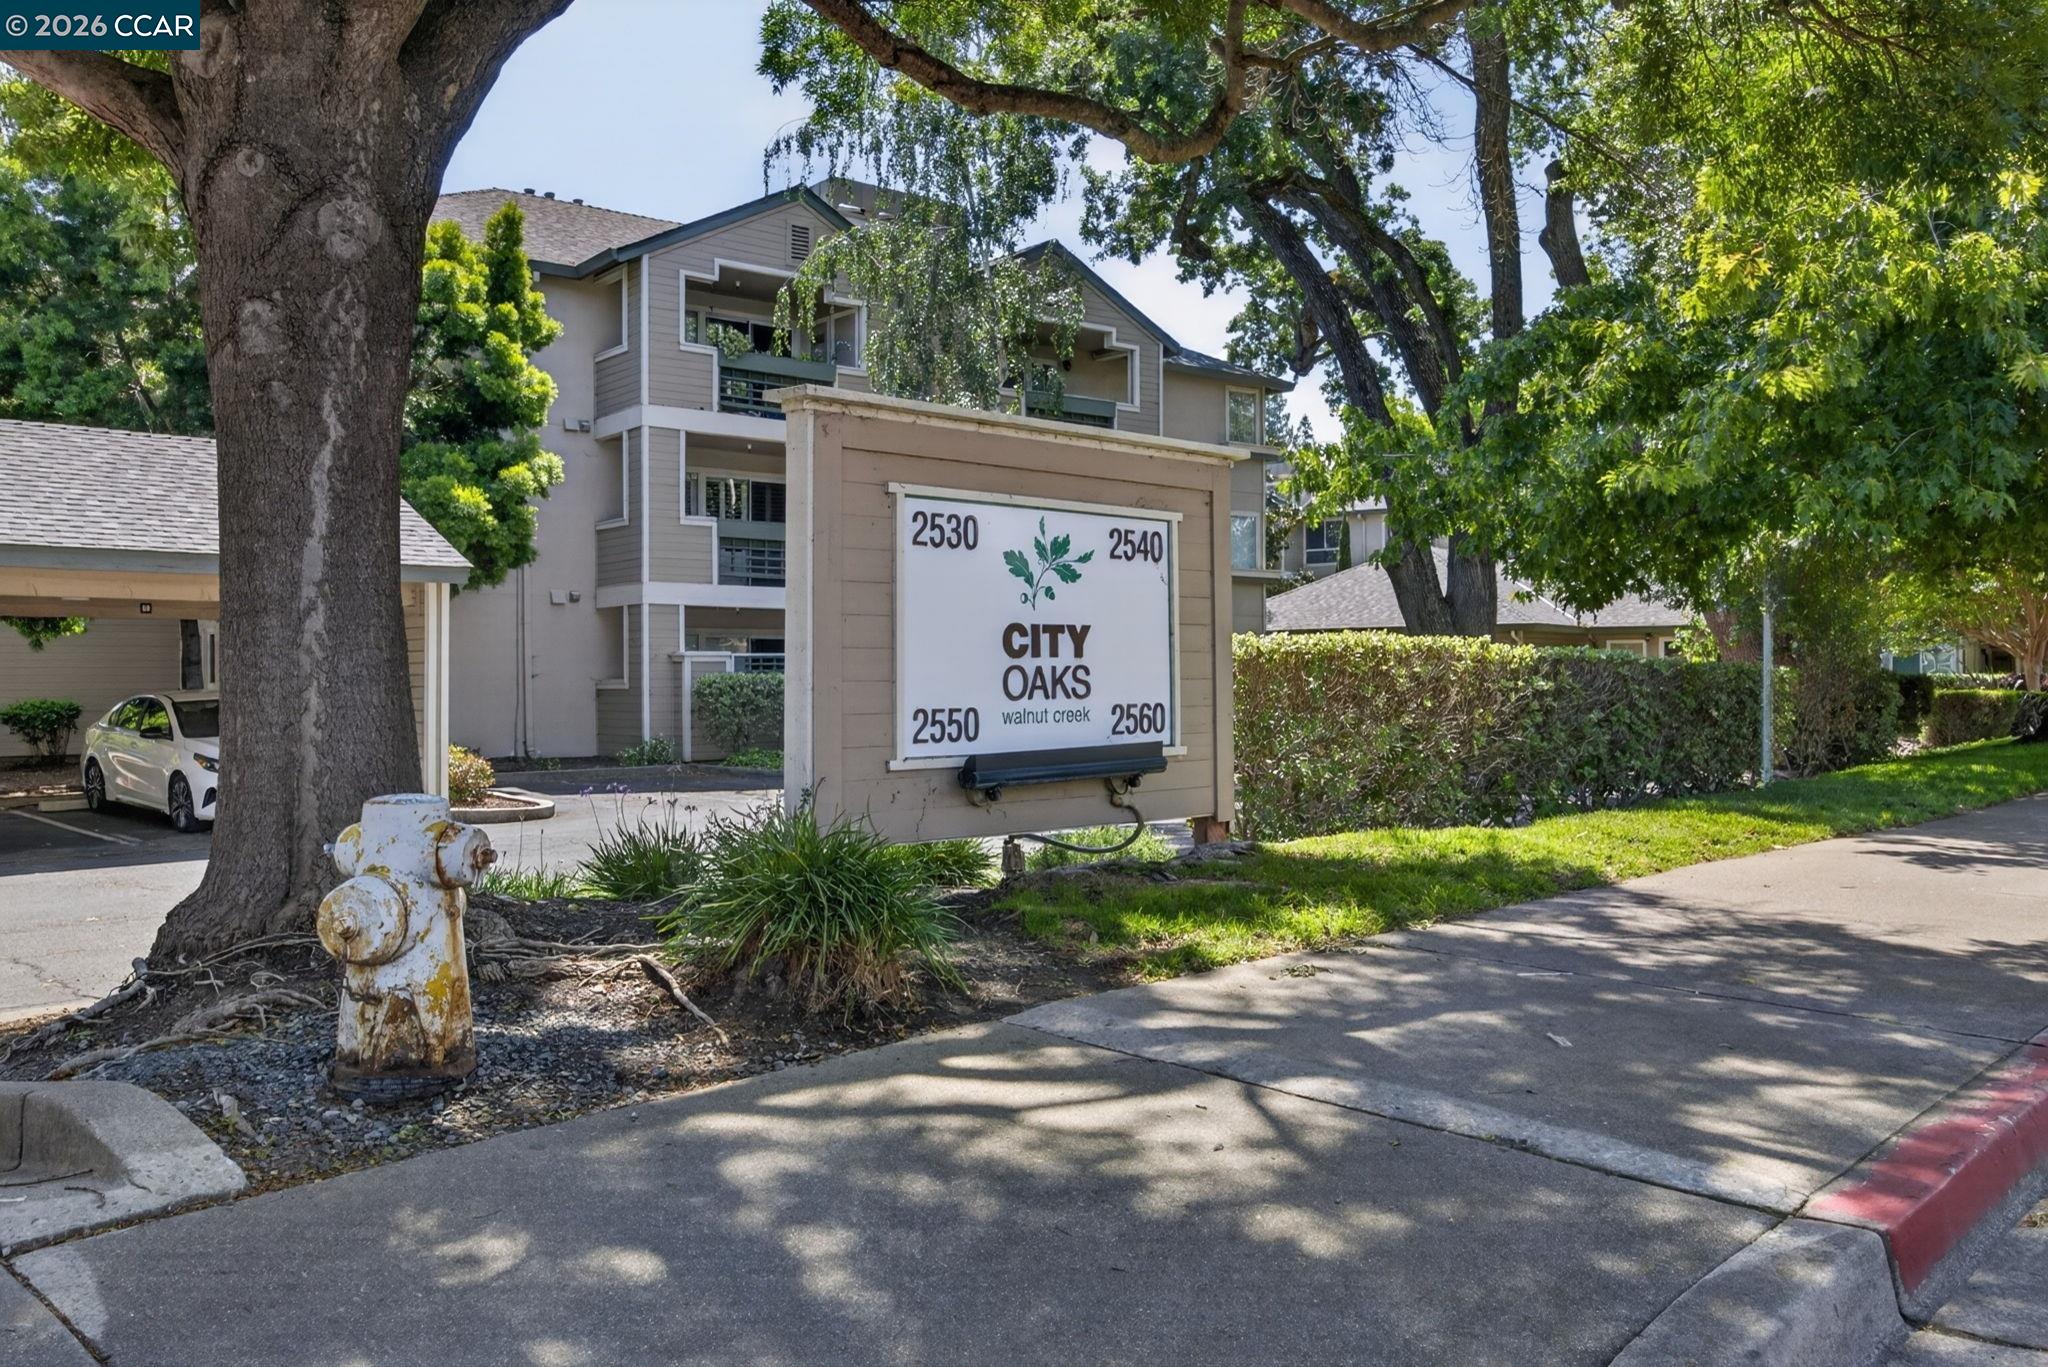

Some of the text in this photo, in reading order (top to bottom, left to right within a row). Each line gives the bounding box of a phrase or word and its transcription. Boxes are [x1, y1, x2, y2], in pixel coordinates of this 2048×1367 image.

[911, 510, 979, 551] 2530
[1108, 527, 1163, 564] 2540
[1002, 622, 1092, 659] CITY
[1002, 664, 1092, 702] OAKS
[912, 706, 980, 744] 2550
[1002, 706, 1091, 726] walnut creek
[1110, 702, 1166, 736] 2560
